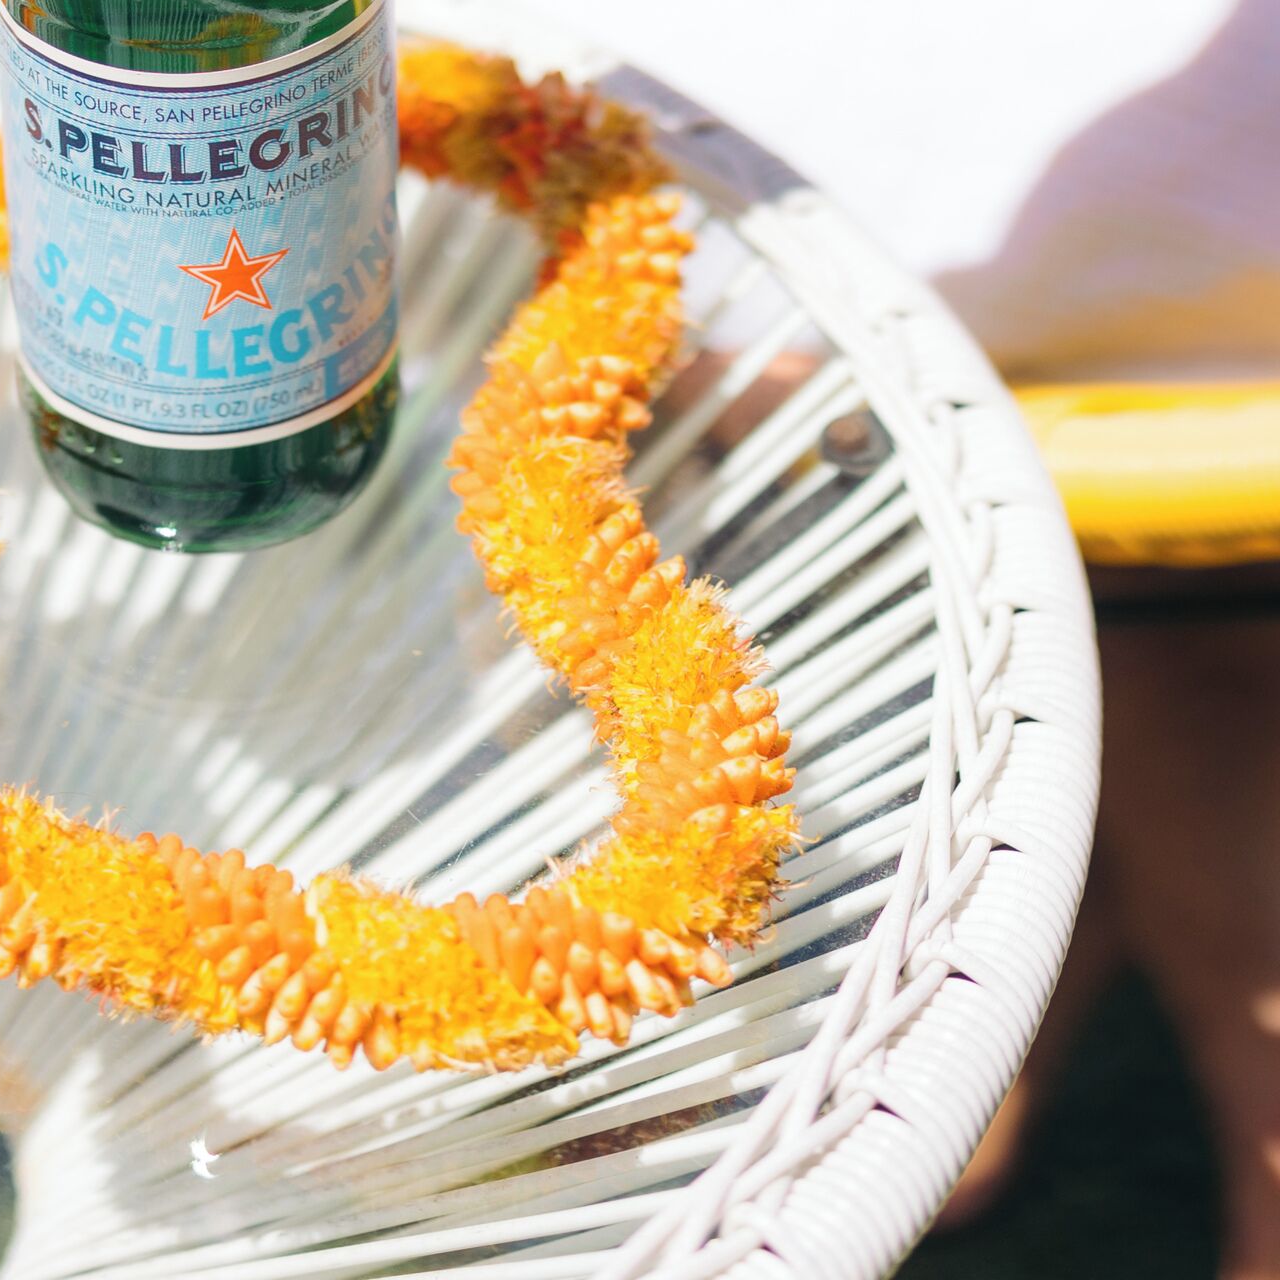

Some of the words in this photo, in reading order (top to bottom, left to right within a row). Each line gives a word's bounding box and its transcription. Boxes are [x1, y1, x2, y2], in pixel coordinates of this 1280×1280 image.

[27, 66, 41, 86] AT
[44, 75, 69, 102] THE
[74, 91, 148, 124] SOURCE,
[154, 107, 195, 124] SAN
[202, 84, 306, 122] PELLEGRINO
[311, 56, 354, 93] TERME
[30, 147, 135, 204] SPARKLING
[145, 185, 257, 209] NATURAL
[266, 144, 352, 197] MINERAL
[94, 197, 127, 212] WATER
[130, 205, 159, 217] WITH
[161, 207, 212, 218] NATURAL
[239, 197, 276, 213] ADDED
[191, 403, 209, 419] FL
[216, 400, 249, 418] OZ)
